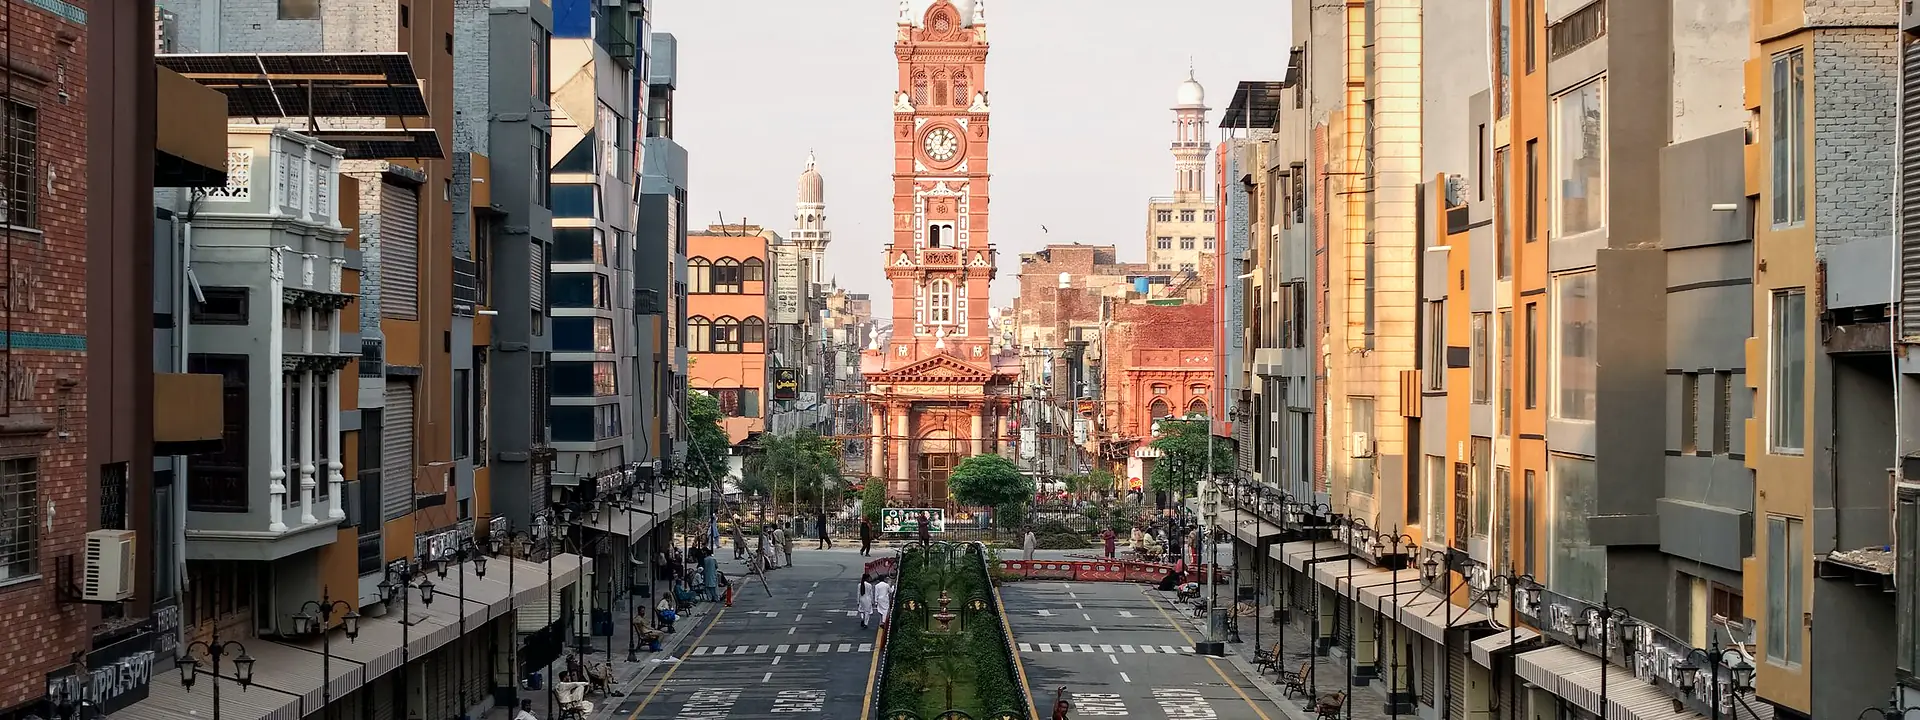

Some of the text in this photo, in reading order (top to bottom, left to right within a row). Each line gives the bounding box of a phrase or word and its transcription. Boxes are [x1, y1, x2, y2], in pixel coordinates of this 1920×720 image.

[91, 661, 126, 703] APPLE
[127, 651, 155, 690] SPOT
[770, 689, 827, 712] BAZAR
[1071, 693, 1129, 716] BAZAR
